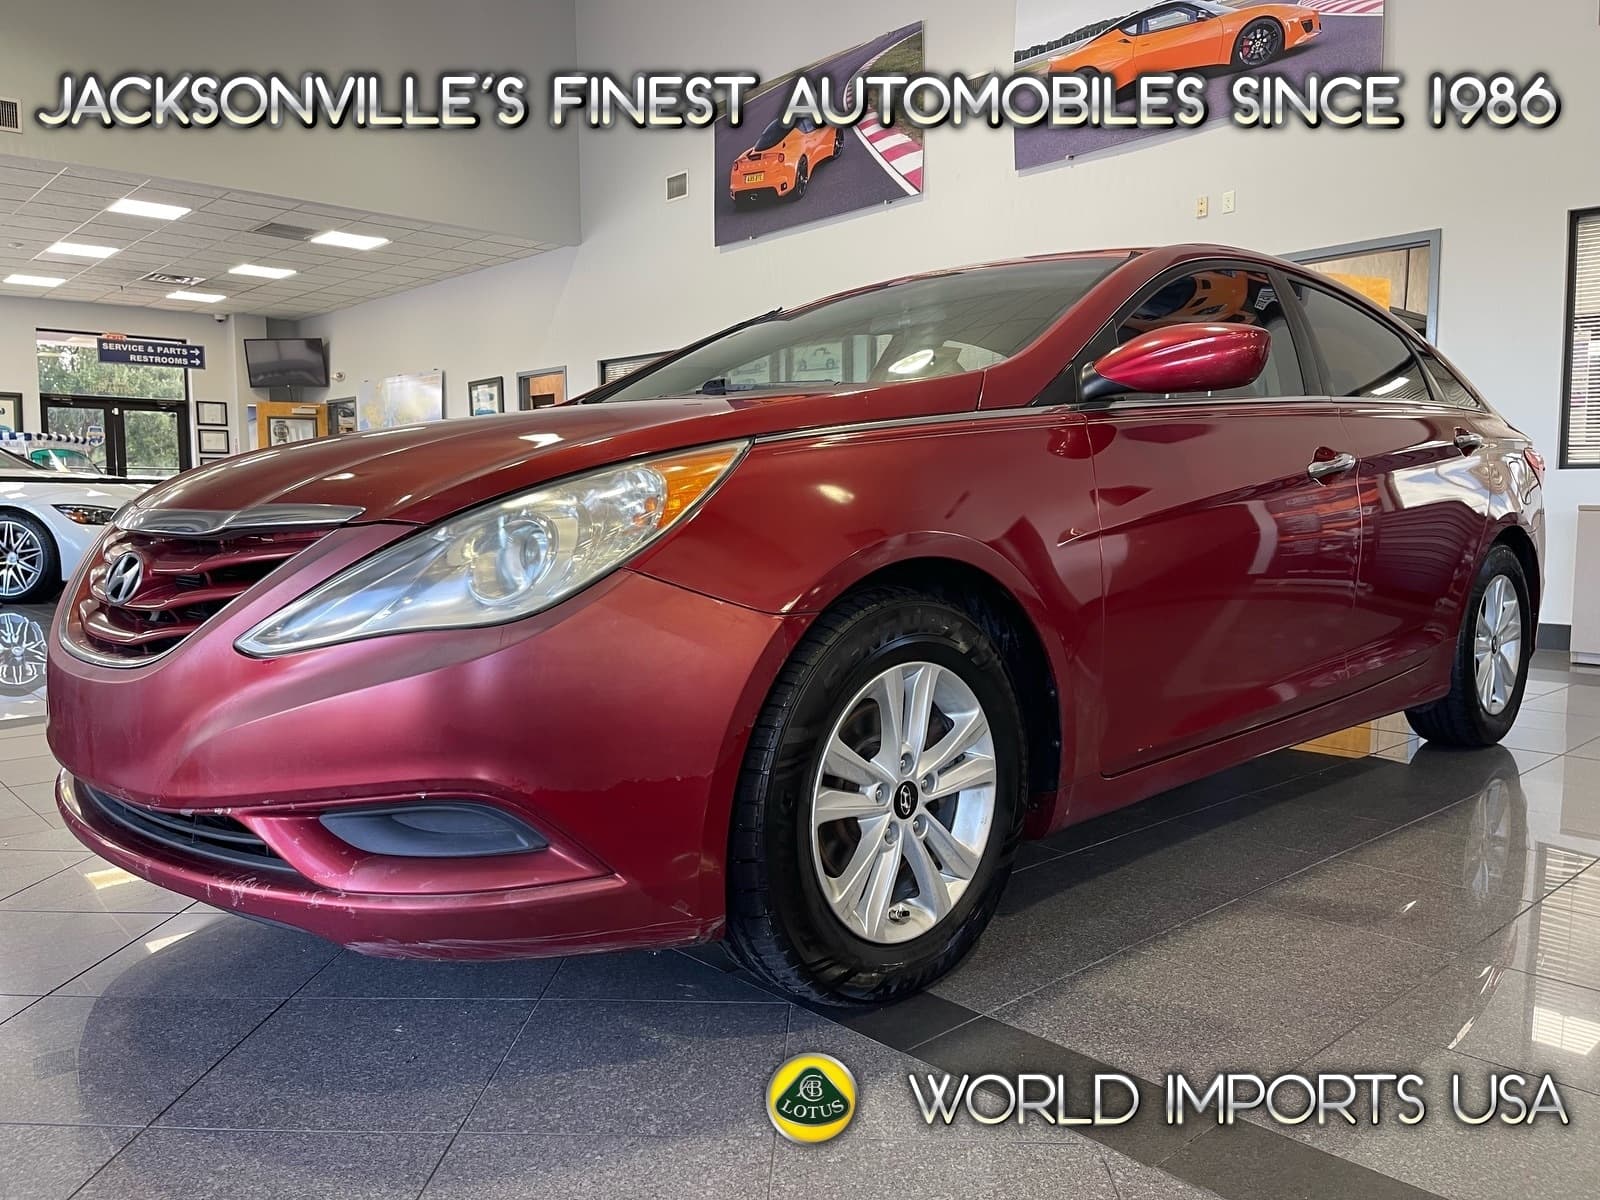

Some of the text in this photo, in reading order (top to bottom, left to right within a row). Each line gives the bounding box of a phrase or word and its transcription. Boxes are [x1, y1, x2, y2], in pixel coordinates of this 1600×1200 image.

[102, 342, 188, 356] SERVICE & PARTS
[129, 354, 189, 365] RESTROOMS
